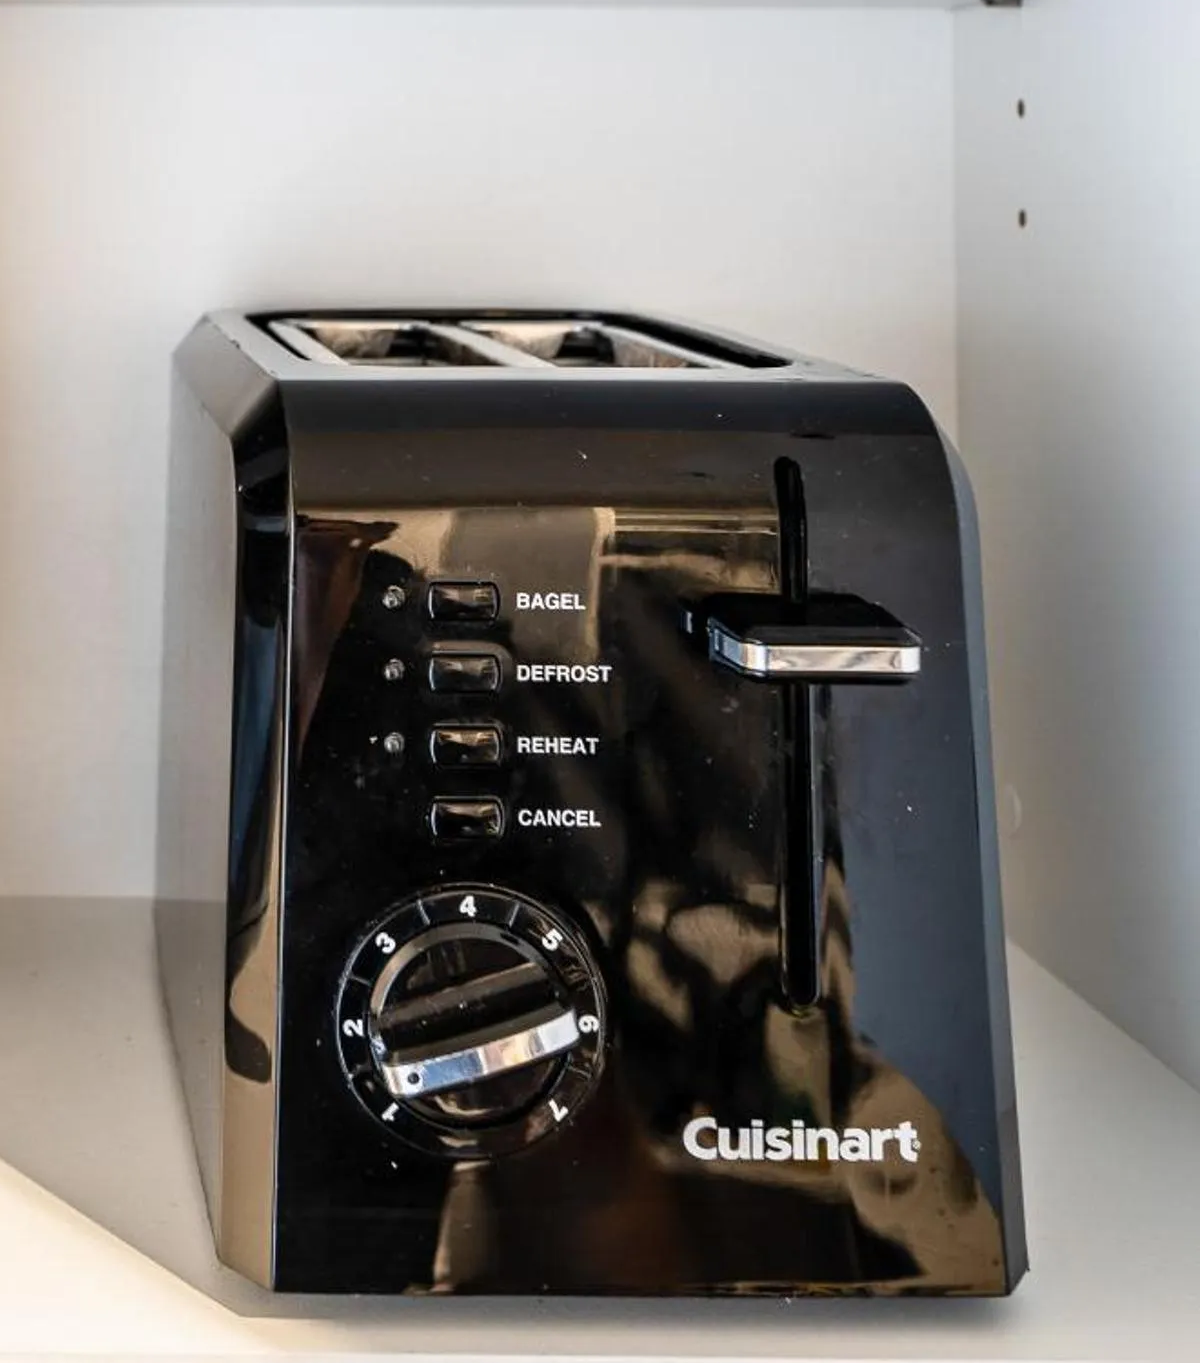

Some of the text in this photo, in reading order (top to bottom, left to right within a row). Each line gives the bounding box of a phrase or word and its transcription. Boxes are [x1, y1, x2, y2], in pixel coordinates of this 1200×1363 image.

[516, 593, 586, 610] BAGEL
[516, 665, 612, 682] DEFROST
[517, 737, 599, 754] REHEAT
[518, 809, 601, 826] CANCEL
[459, 896, 477, 917] 4
[375, 932, 396, 954] 3
[542, 928, 563, 951] 5
[342, 1018, 364, 1037] 2
[578, 1014, 600, 1033] 6
[381, 1102, 399, 1122] 1
[549, 1100, 568, 1122] 7
[683, 1117, 919, 1162] Cuisinart
